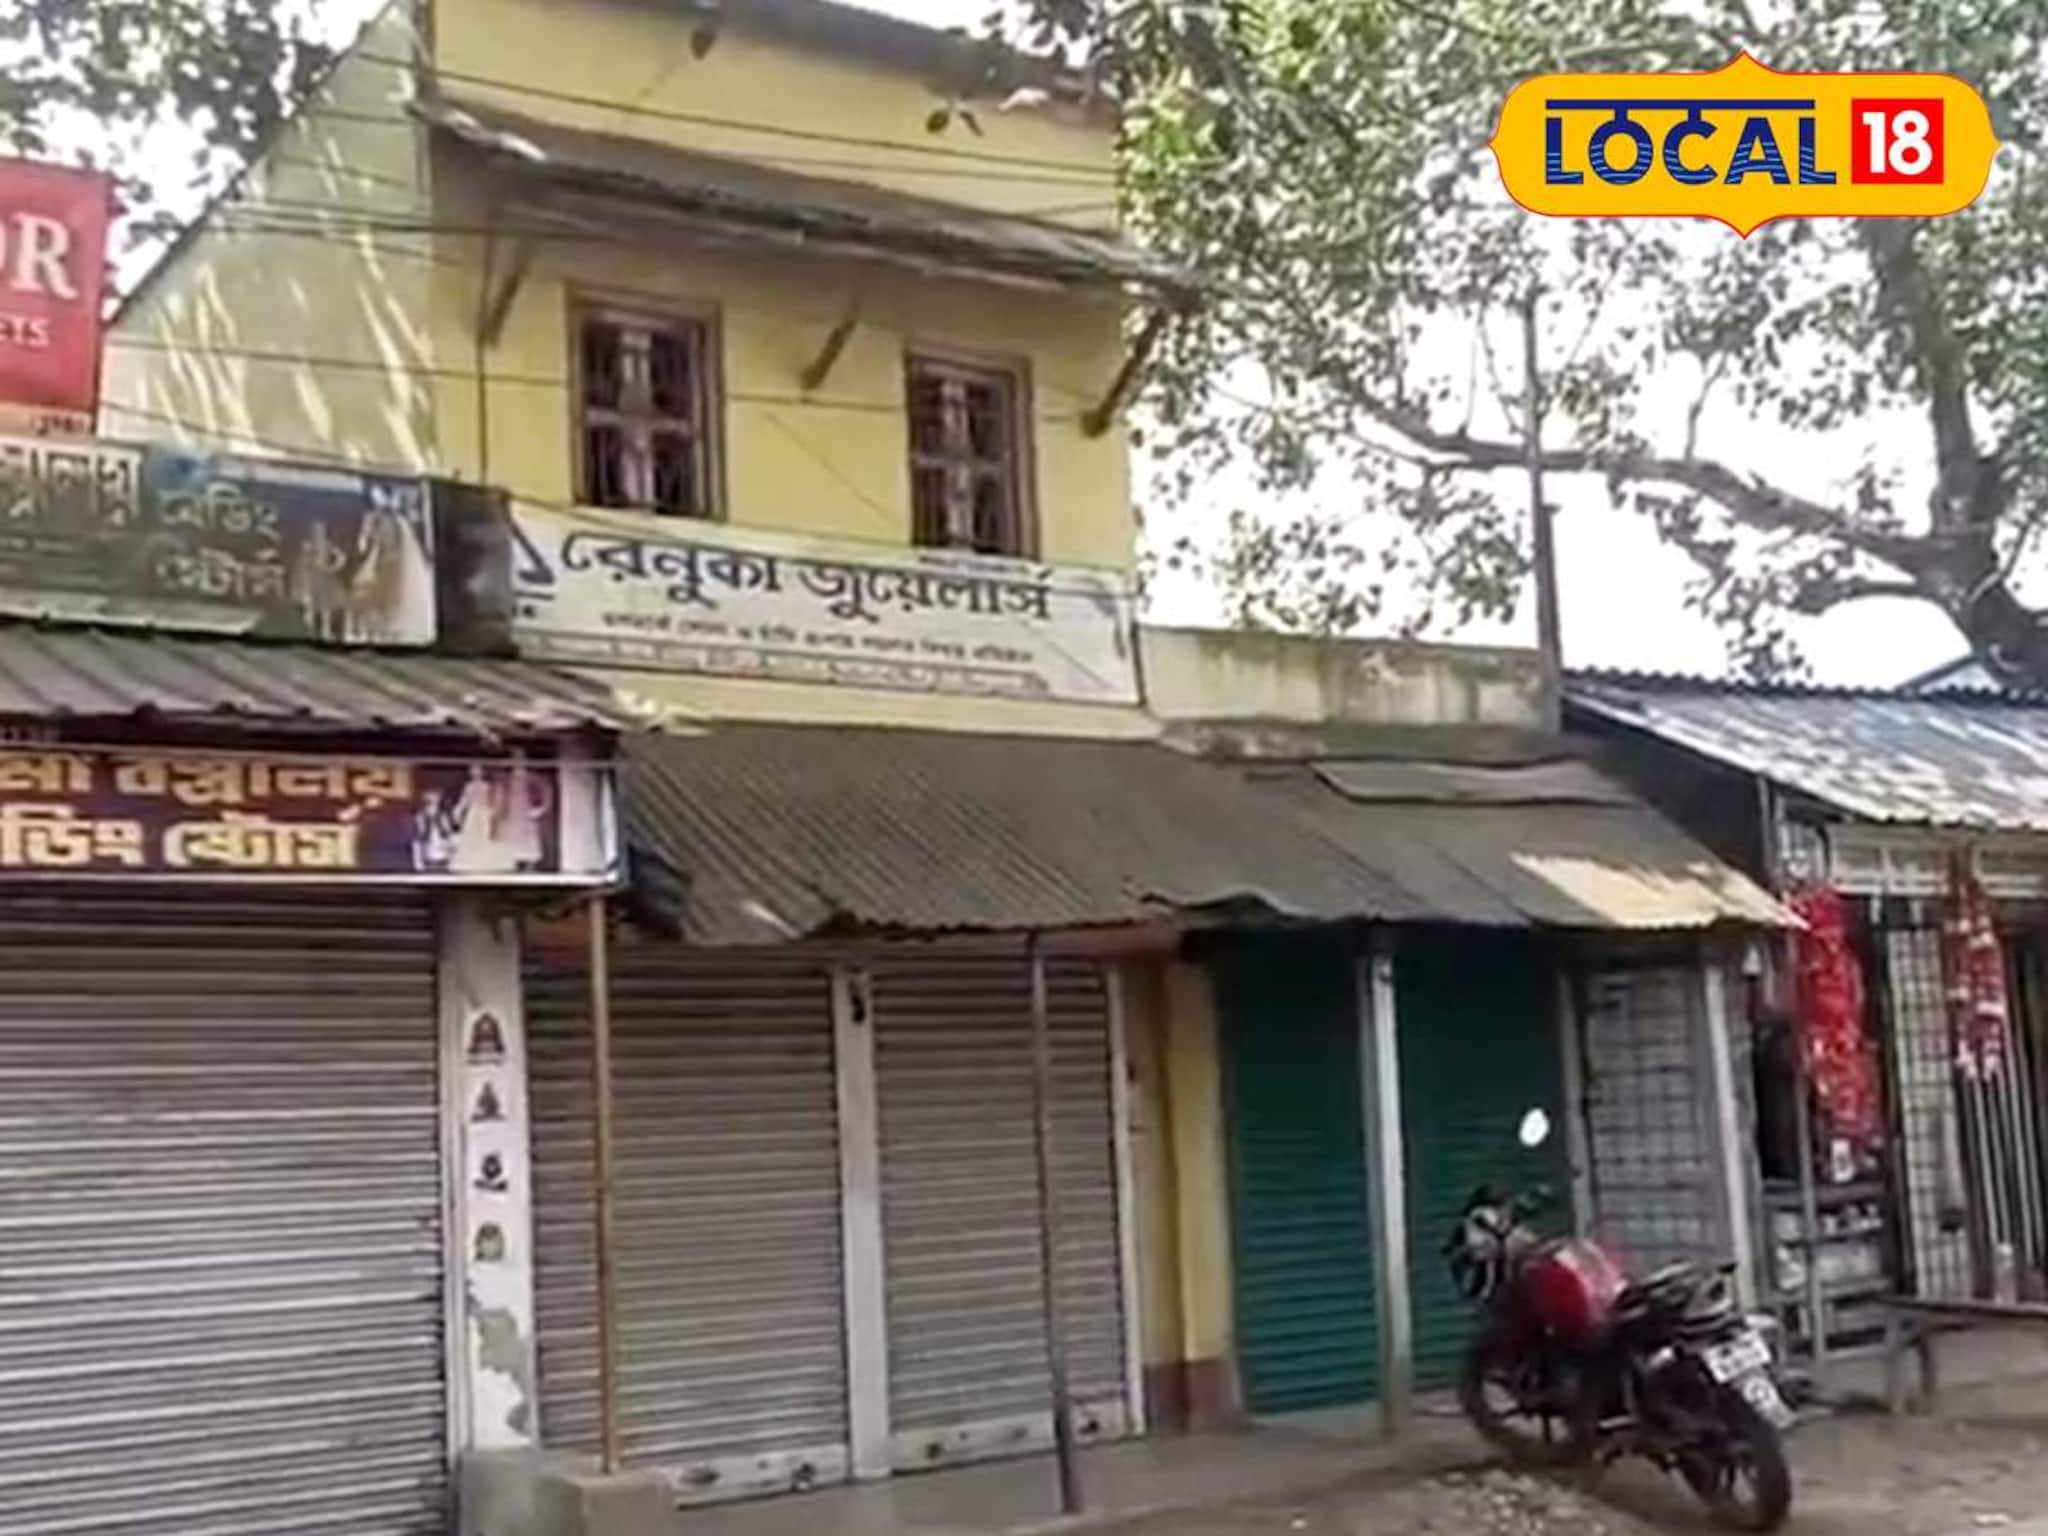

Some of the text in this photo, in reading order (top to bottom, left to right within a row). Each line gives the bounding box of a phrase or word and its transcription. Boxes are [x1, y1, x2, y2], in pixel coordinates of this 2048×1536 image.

[0, 212, 77, 299] R
[562, 530, 782, 609] রেনুকা
[797, 563, 1053, 624] জুয়েলার্স
